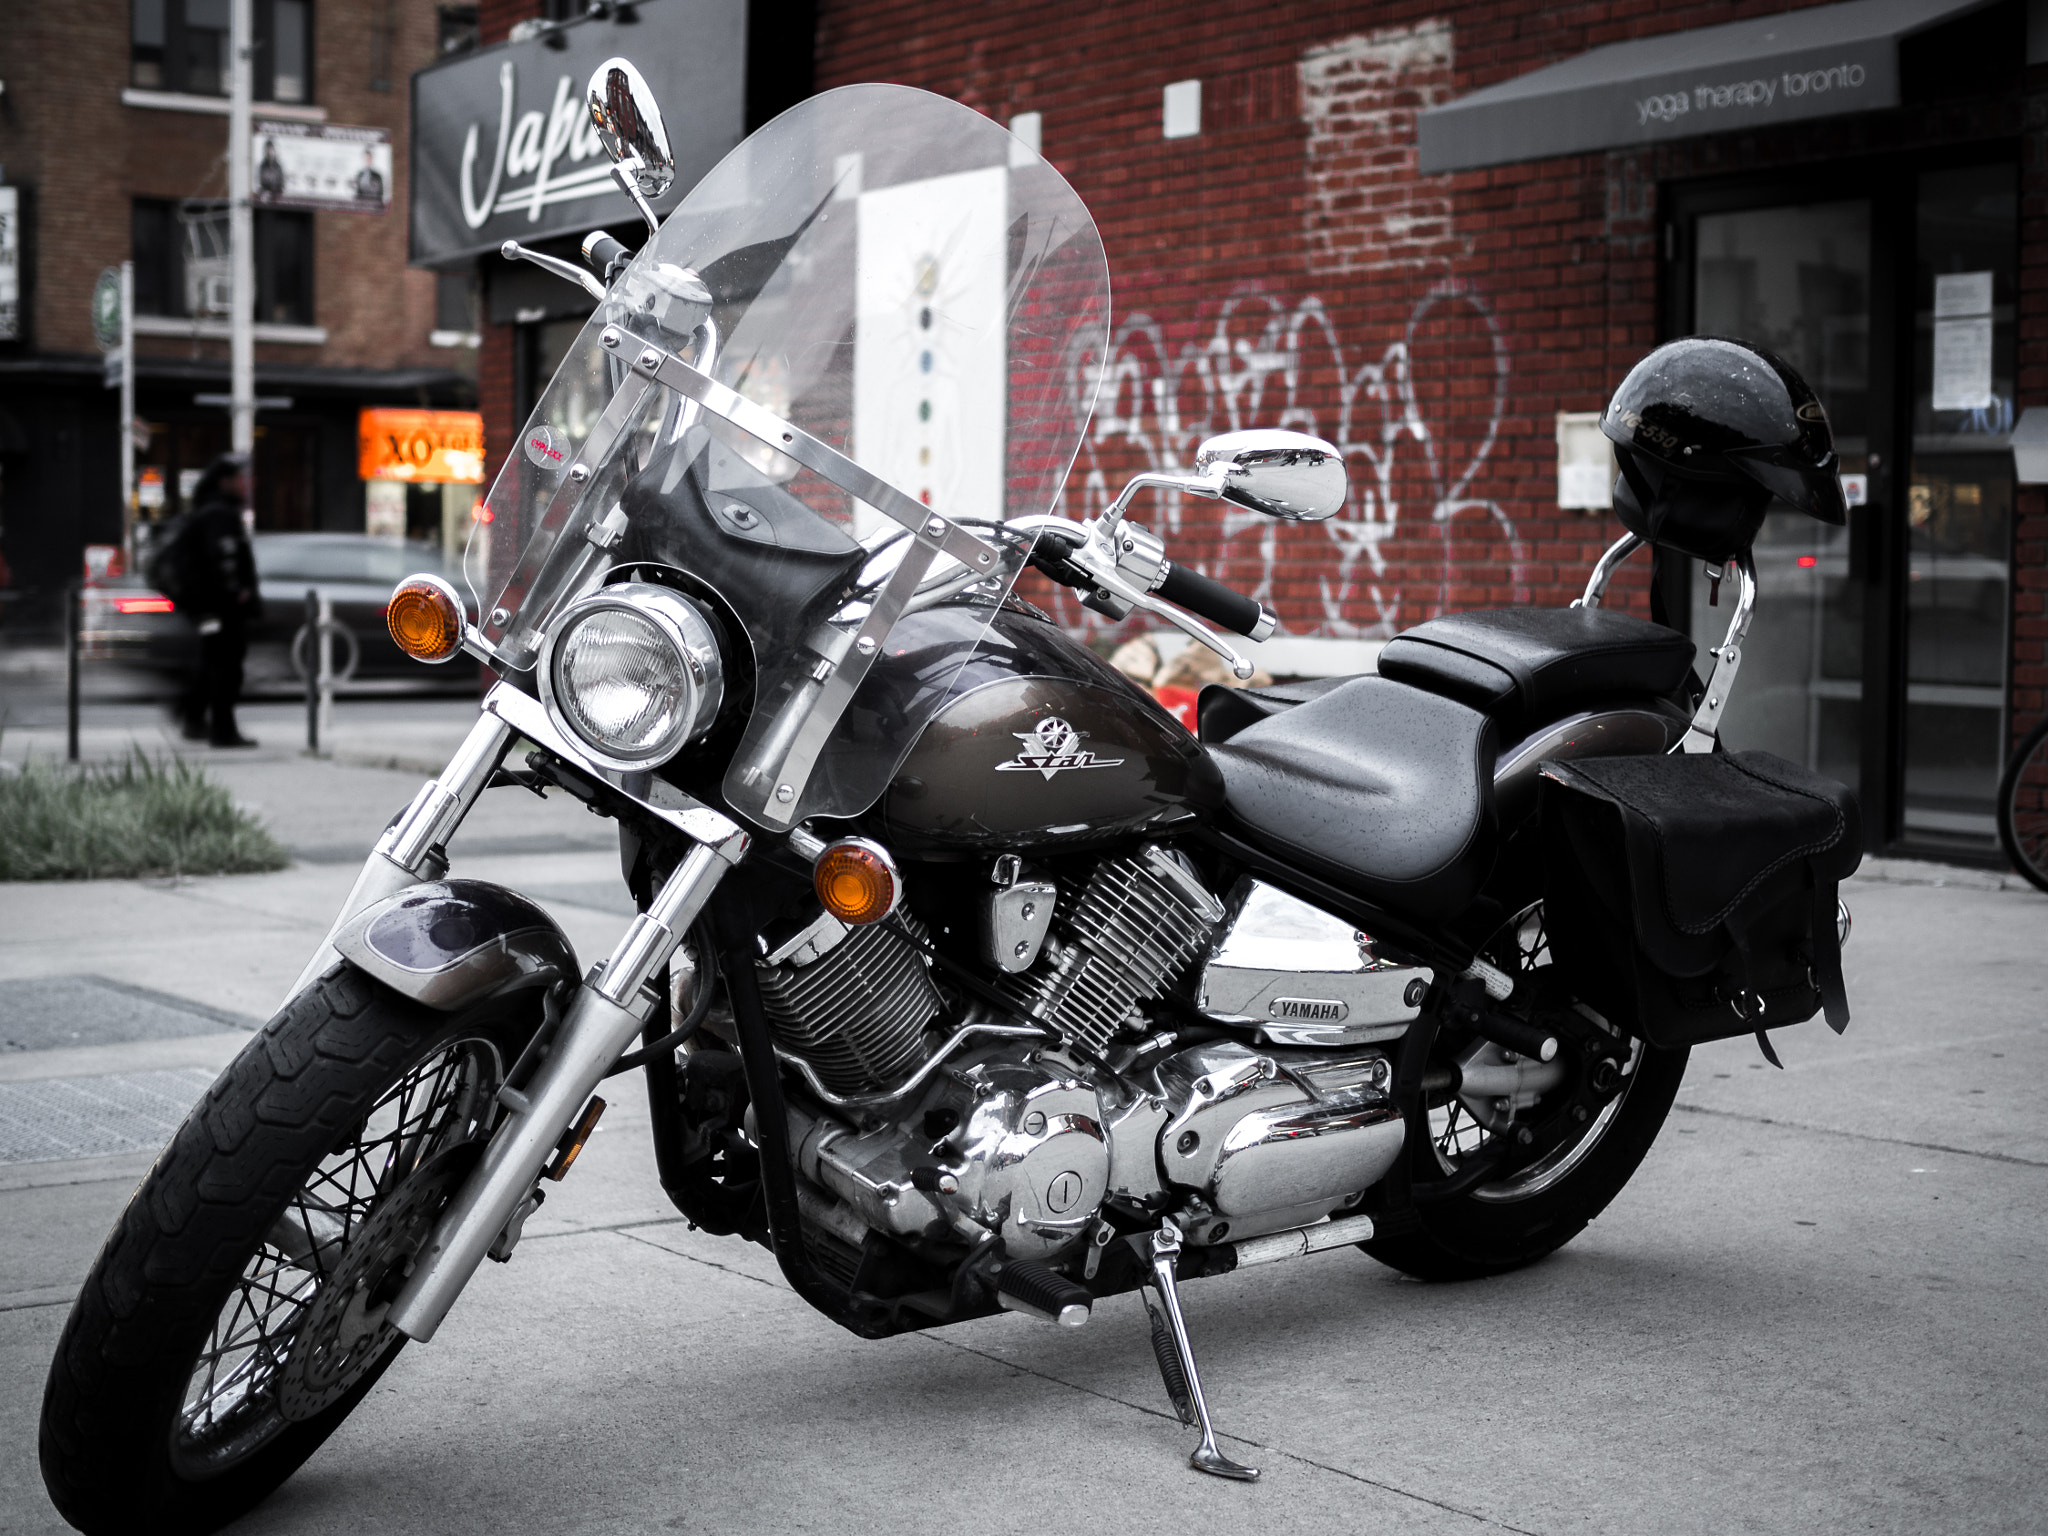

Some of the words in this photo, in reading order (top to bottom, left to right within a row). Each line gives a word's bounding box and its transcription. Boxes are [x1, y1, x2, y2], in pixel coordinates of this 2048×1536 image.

[1636, 91, 1690, 126] yoga
[1694, 78, 1778, 110] therapy
[1783, 63, 1866, 98] toronto
[460, 61, 603, 227] Japa
[378, 428, 434, 468] XO
[1620, 409, 1679, 449] VG-550
[1281, 1001, 1339, 1019] YAMAHA
